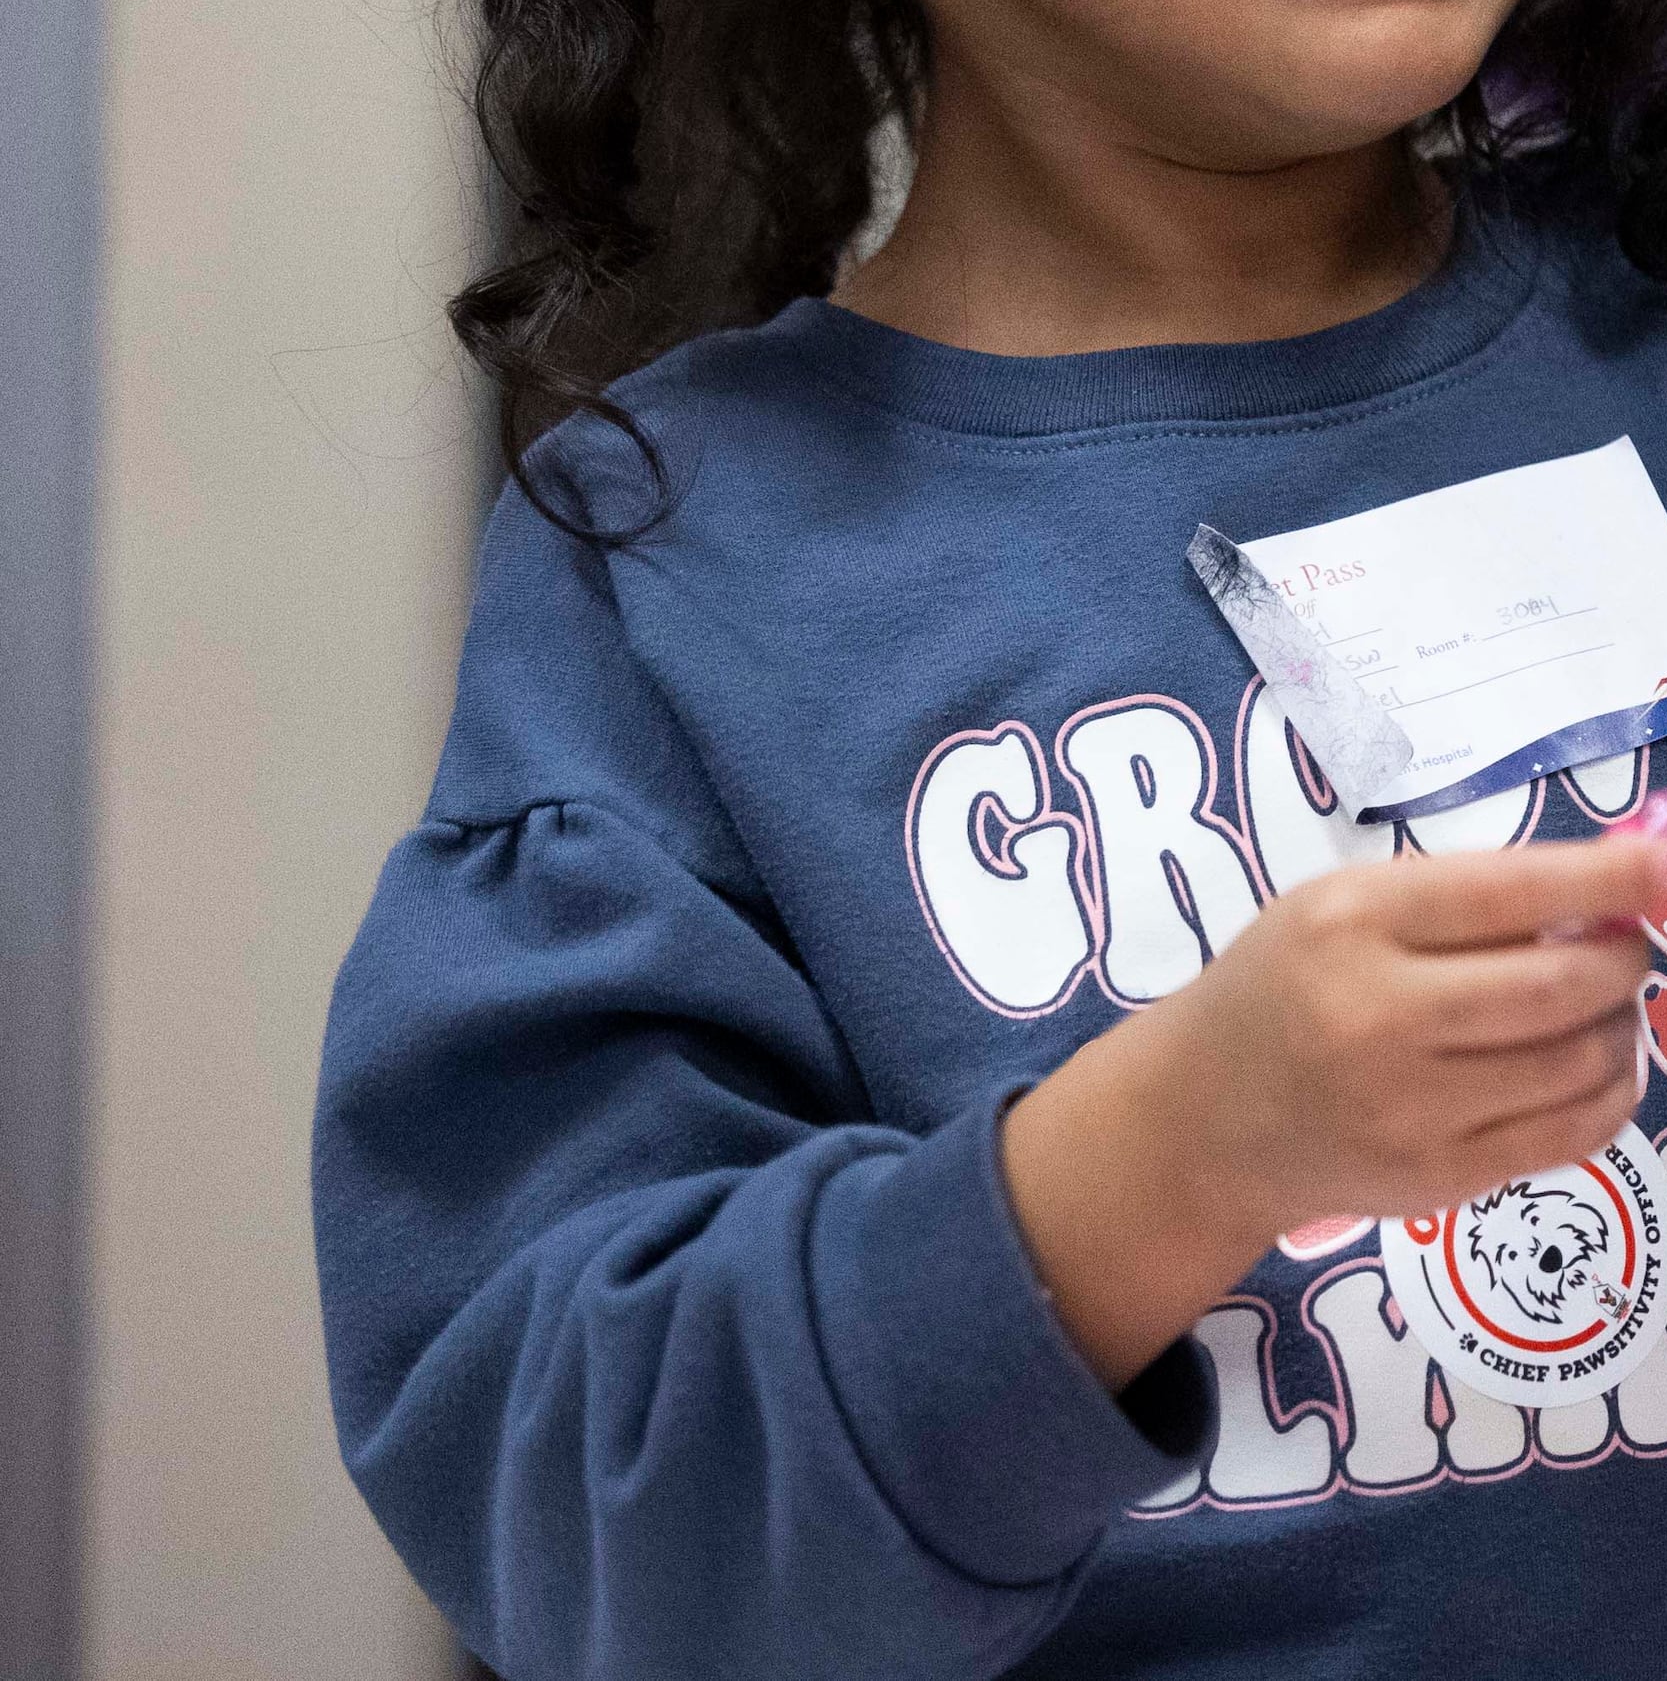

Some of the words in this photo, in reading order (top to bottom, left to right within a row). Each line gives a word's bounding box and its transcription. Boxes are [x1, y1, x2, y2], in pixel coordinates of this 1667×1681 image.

[1299, 560, 1367, 591] Pass
[1294, 599, 1317, 619] Off
[1416, 639, 1459, 659] Room
[1421, 743, 1475, 769] Hospital
[1605, 1143, 1661, 1245] OFFICER
[1558, 1253, 1661, 1382] PAWSITIVITY
[1480, 1347, 1549, 1382] CHIEF
